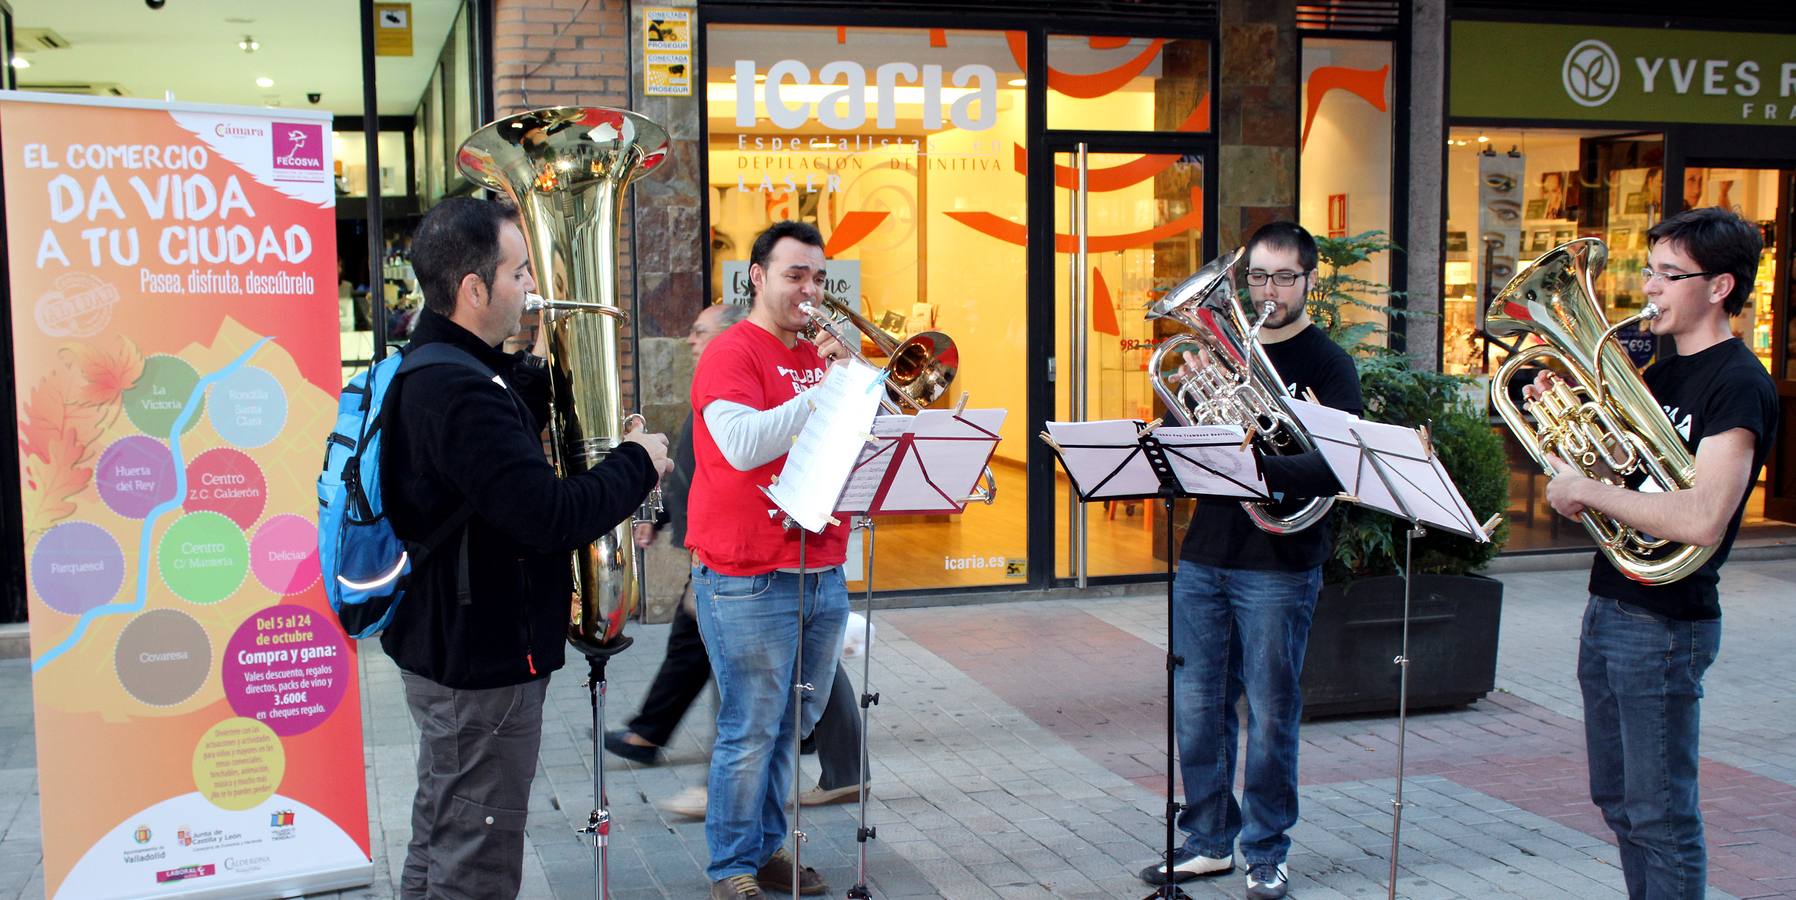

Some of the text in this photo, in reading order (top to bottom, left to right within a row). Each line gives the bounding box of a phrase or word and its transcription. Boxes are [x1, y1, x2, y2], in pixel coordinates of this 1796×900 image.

[1635, 57, 1761, 97] YVES
[214, 123, 264, 137] Cámara
[738, 134, 1002, 152] Especialistas en
[24, 143, 208, 170] EL COMERCIO
[277, 156, 320, 167] FECOSVA
[890, 156, 1001, 171] DEINITIVA
[737, 174, 843, 193] LASER
[48, 173, 256, 223] DA VIDA
[36, 224, 312, 268] A TU CIUDAD
[140, 268, 314, 295] Pasea, disfruta, descúbrelo
[152, 385, 166, 395] La
[142, 400, 182, 410] Victoria
[115, 465, 151, 476] Huerta
[201, 472, 245, 485] Centro
[116, 480, 155, 493] del Rey
[214, 486, 259, 499] Calderón
[182, 542, 225, 554] Centro
[268, 550, 306, 562] Delicias
[945, 555, 1005, 570] icaria.es
[51, 562, 104, 575] Parquesol
[256, 614, 311, 630] Del 5 al 24
[256, 630, 313, 645] de octubre
[139, 651, 188, 663] Covaresa
[238, 645, 337, 666] Compra y gana:
[244, 664, 332, 682] Vales descuento, regalos
[246, 677, 333, 694] directos, packs de vino y
[274, 691, 307, 706] 3.600€
[256, 703, 326, 720] en cheques regalo.
[192, 831, 212, 839] Junta
[192, 836, 217, 845] Castilla
[224, 833, 242, 841] León
[123, 851, 166, 863] Valladolid
